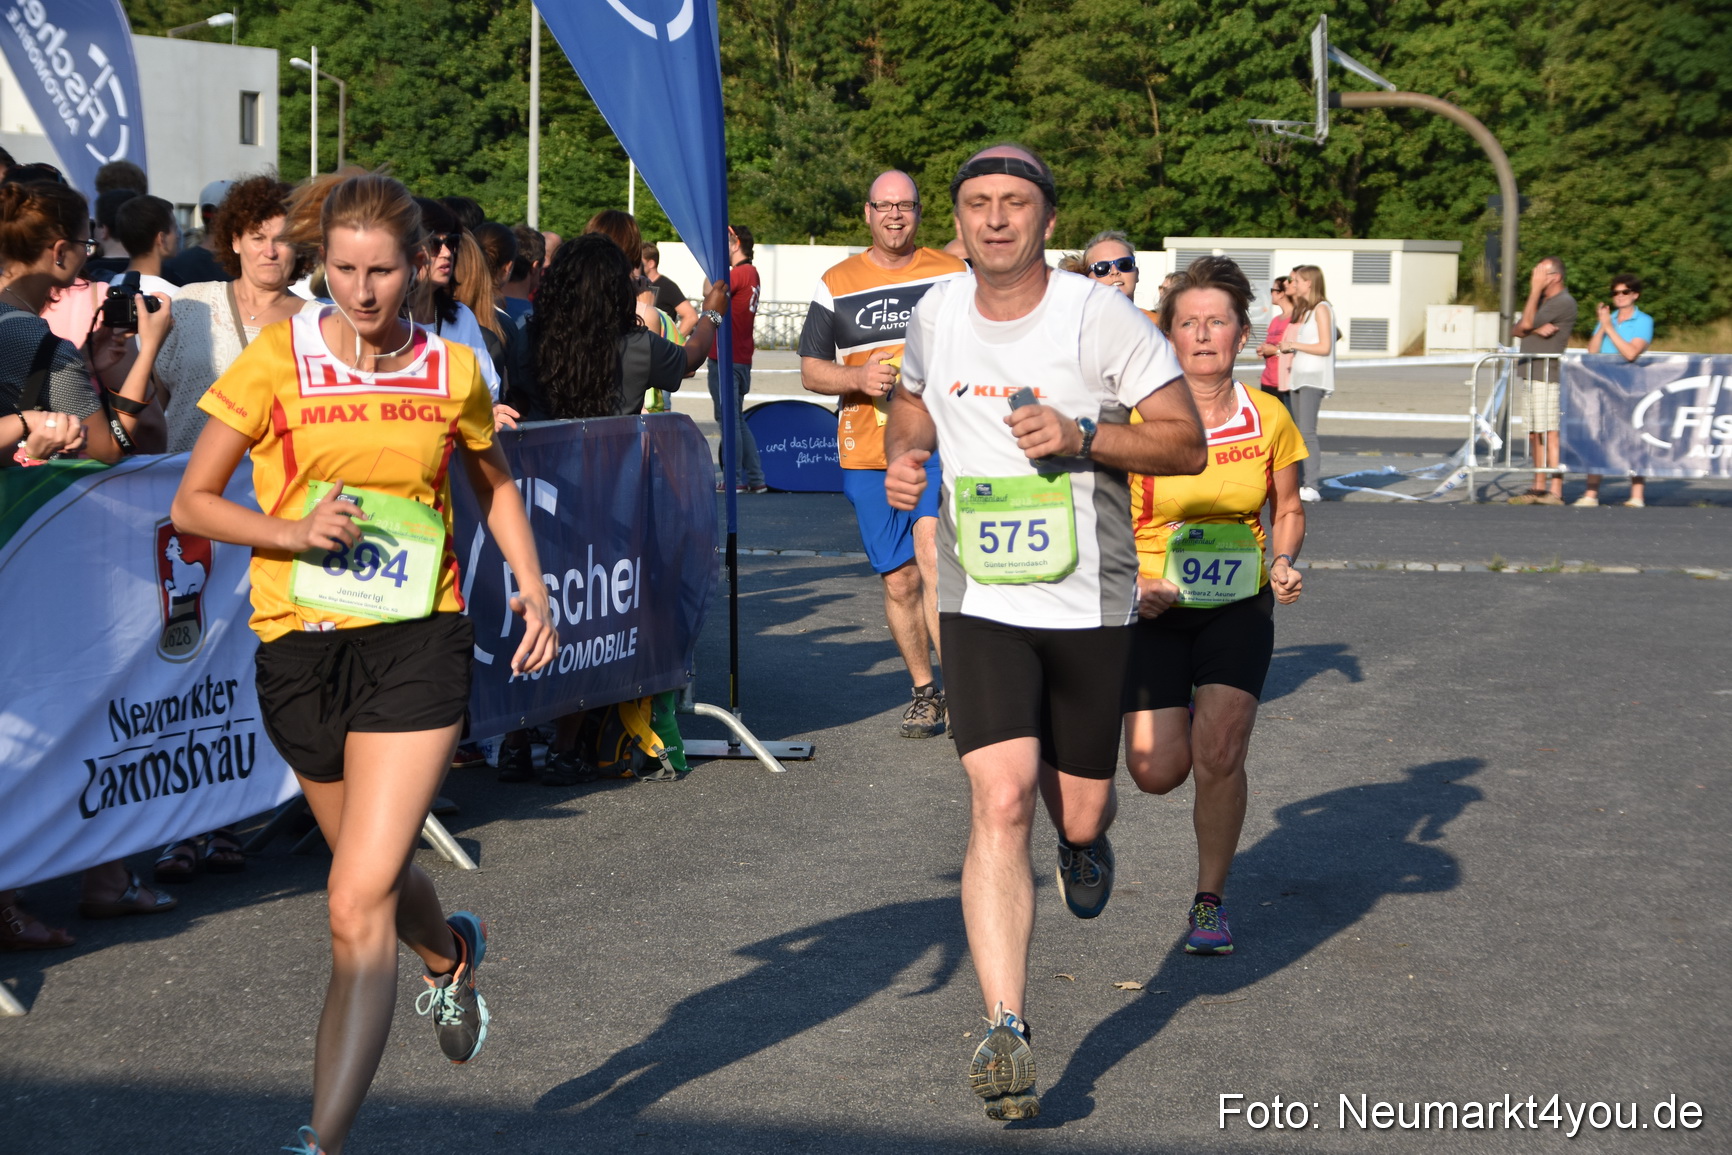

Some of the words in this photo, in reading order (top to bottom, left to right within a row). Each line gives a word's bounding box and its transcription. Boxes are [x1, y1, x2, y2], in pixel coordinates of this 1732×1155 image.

[871, 306, 916, 325] Fisc
[973, 384, 1048, 398] KLEL
[301, 403, 369, 424] MAX
[380, 399, 447, 423] BÖGL
[110, 419, 131, 447] SONY
[765, 438, 787, 453] und
[789, 436, 808, 449] das
[1215, 444, 1266, 465] BÖGL
[796, 451, 822, 469] fährt
[979, 518, 1050, 554] 575
[322, 536, 409, 589] 894
[983, 560, 1007, 568] Günter
[1008, 559, 1048, 568] Horndasch
[1182, 557, 1242, 586] 947
[337, 587, 372, 600] Jennifer
[372, 592, 384, 603] Igl
[499, 543, 641, 638] Fscher
[163, 625, 192, 648] 1628
